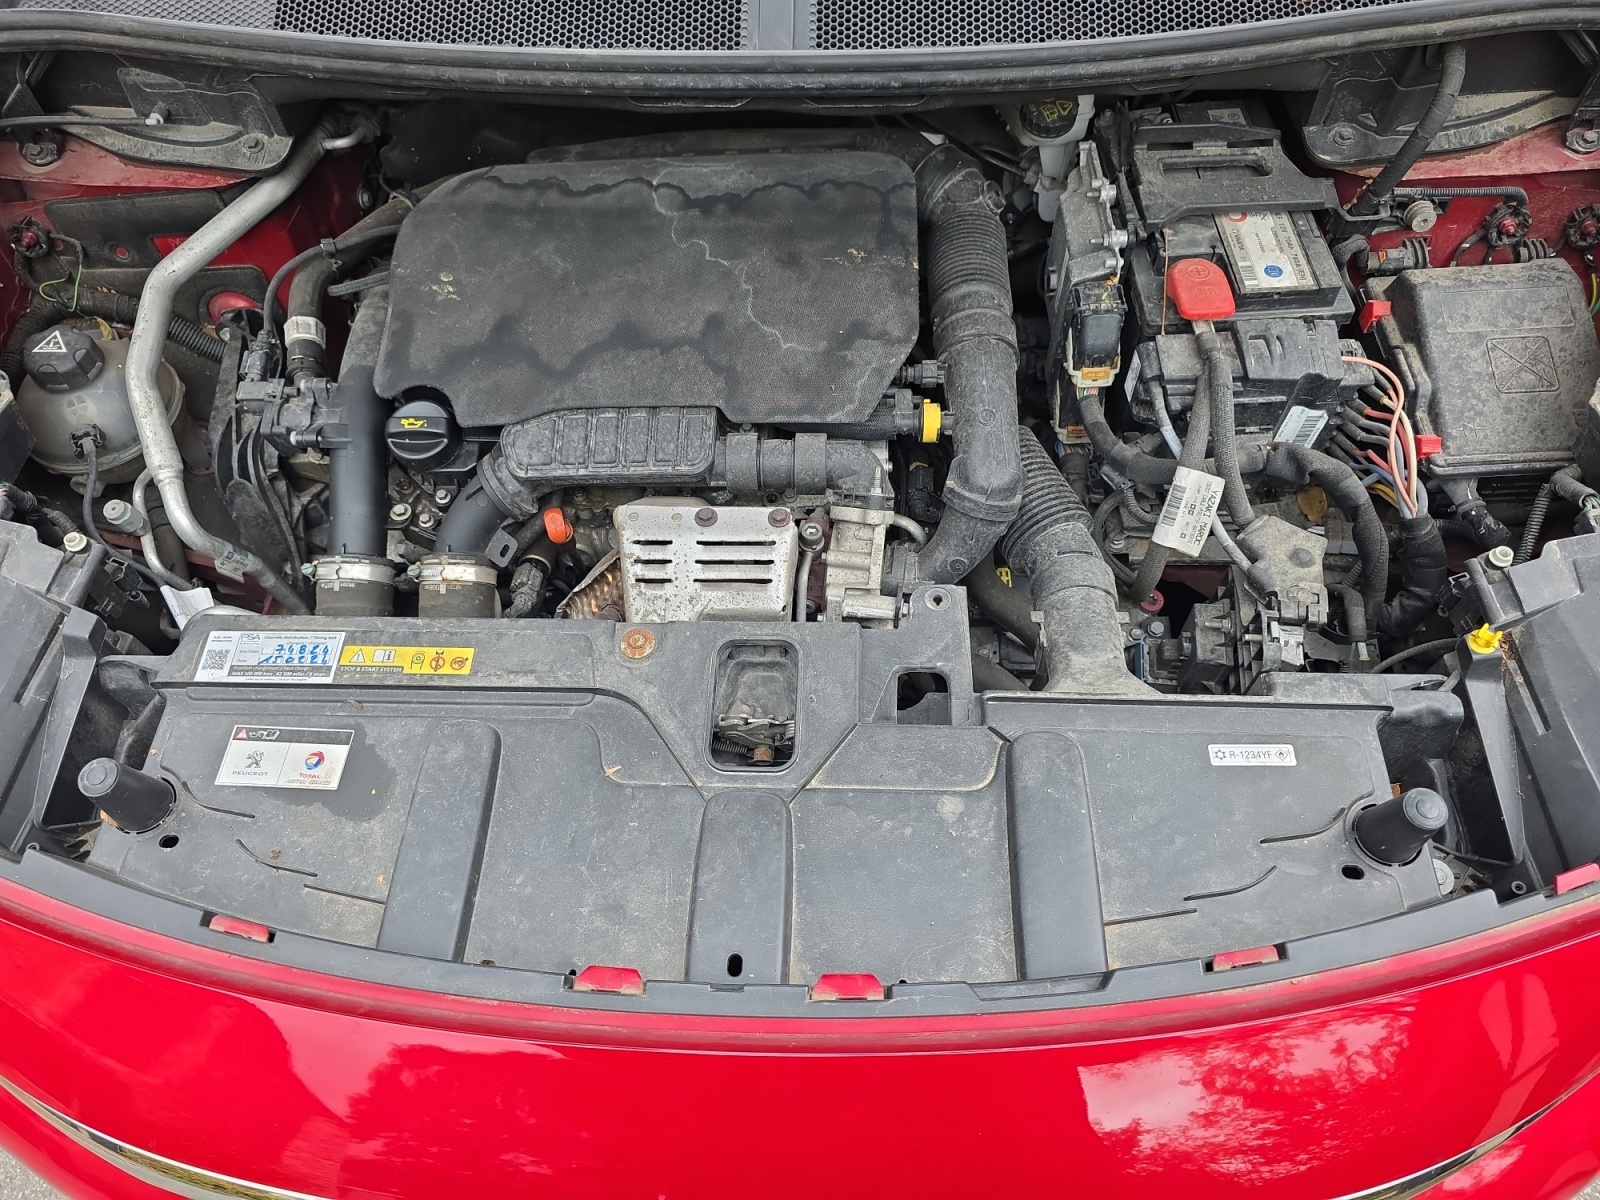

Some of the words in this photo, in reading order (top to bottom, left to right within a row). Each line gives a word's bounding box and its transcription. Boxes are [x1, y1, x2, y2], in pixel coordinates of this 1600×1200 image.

[1202, 490, 1219, 518] YAZAKI
[1194, 522, 1208, 546] MAROC
[1229, 751, 1272, 759] R-1234YF
